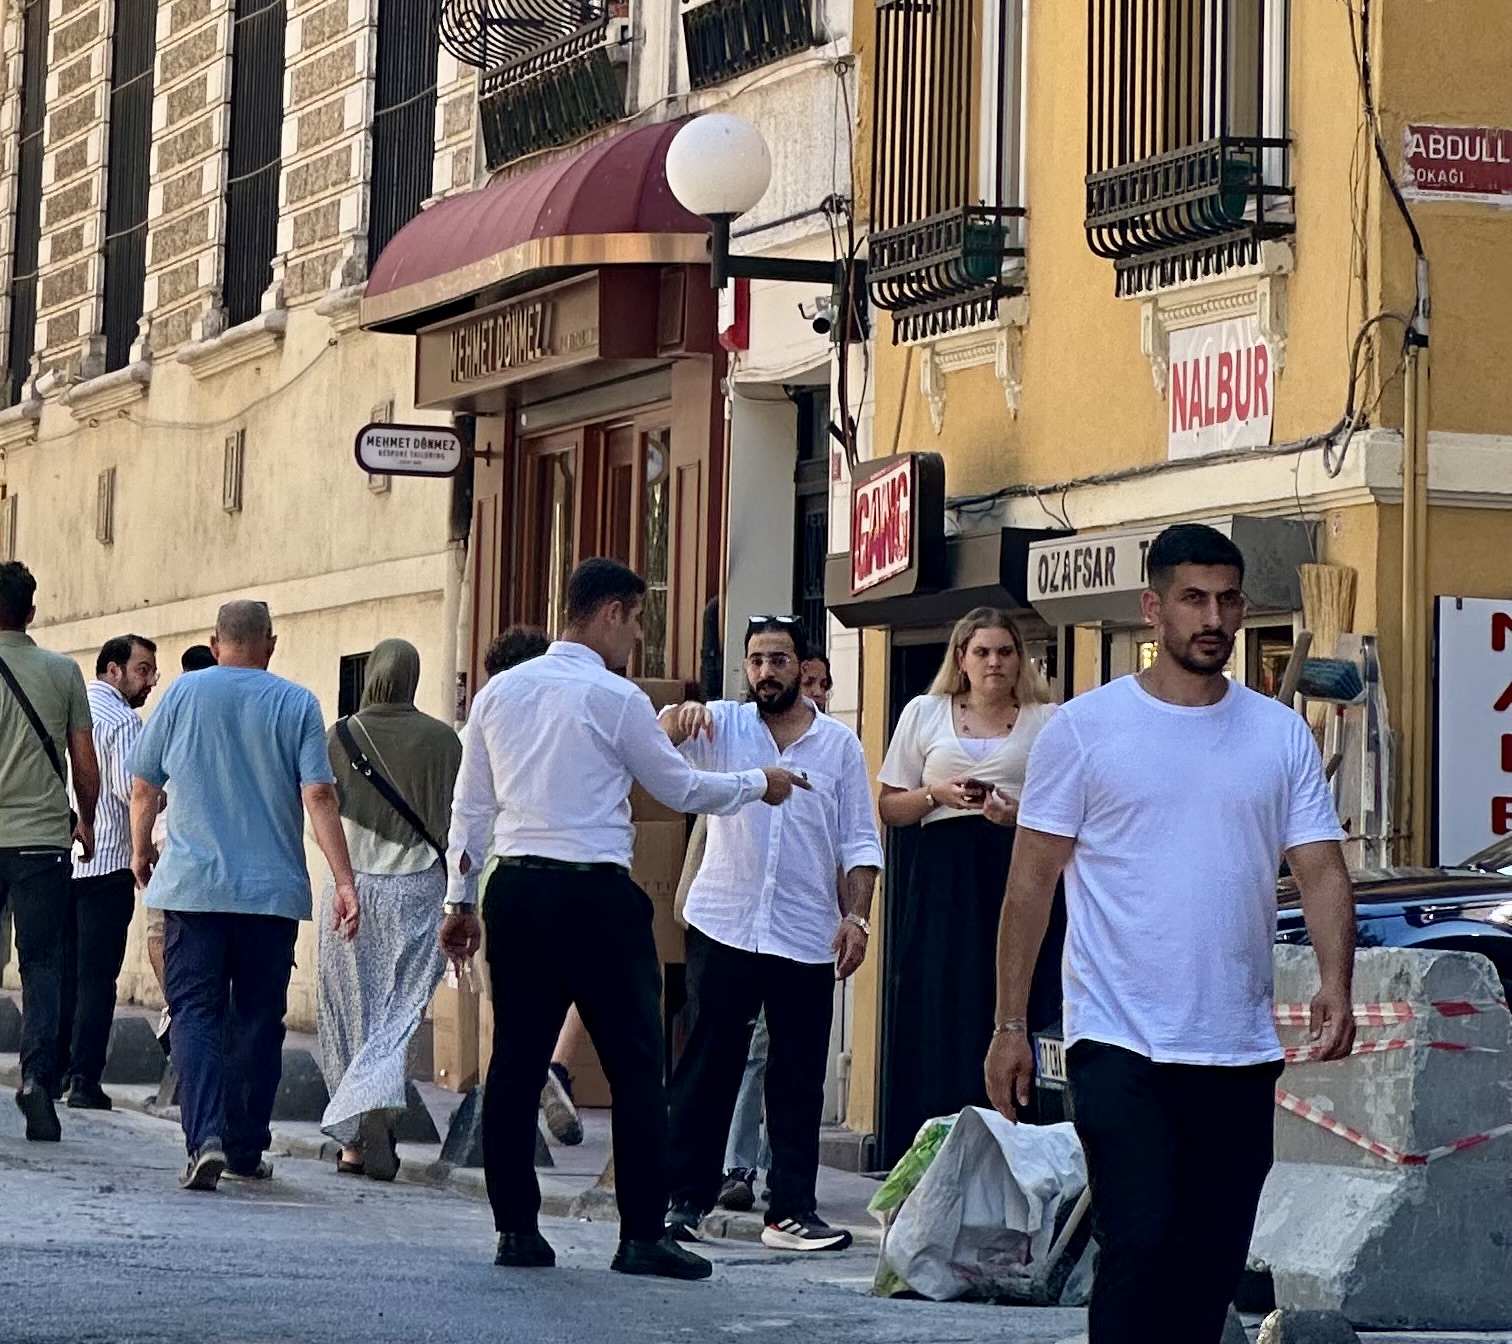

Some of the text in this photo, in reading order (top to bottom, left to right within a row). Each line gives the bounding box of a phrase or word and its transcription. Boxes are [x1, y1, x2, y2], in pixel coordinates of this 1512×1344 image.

[1172, 344, 1269, 433] NALBUR
[366, 435, 410, 449] MEHMET
[855, 471, 909, 581] GANG
